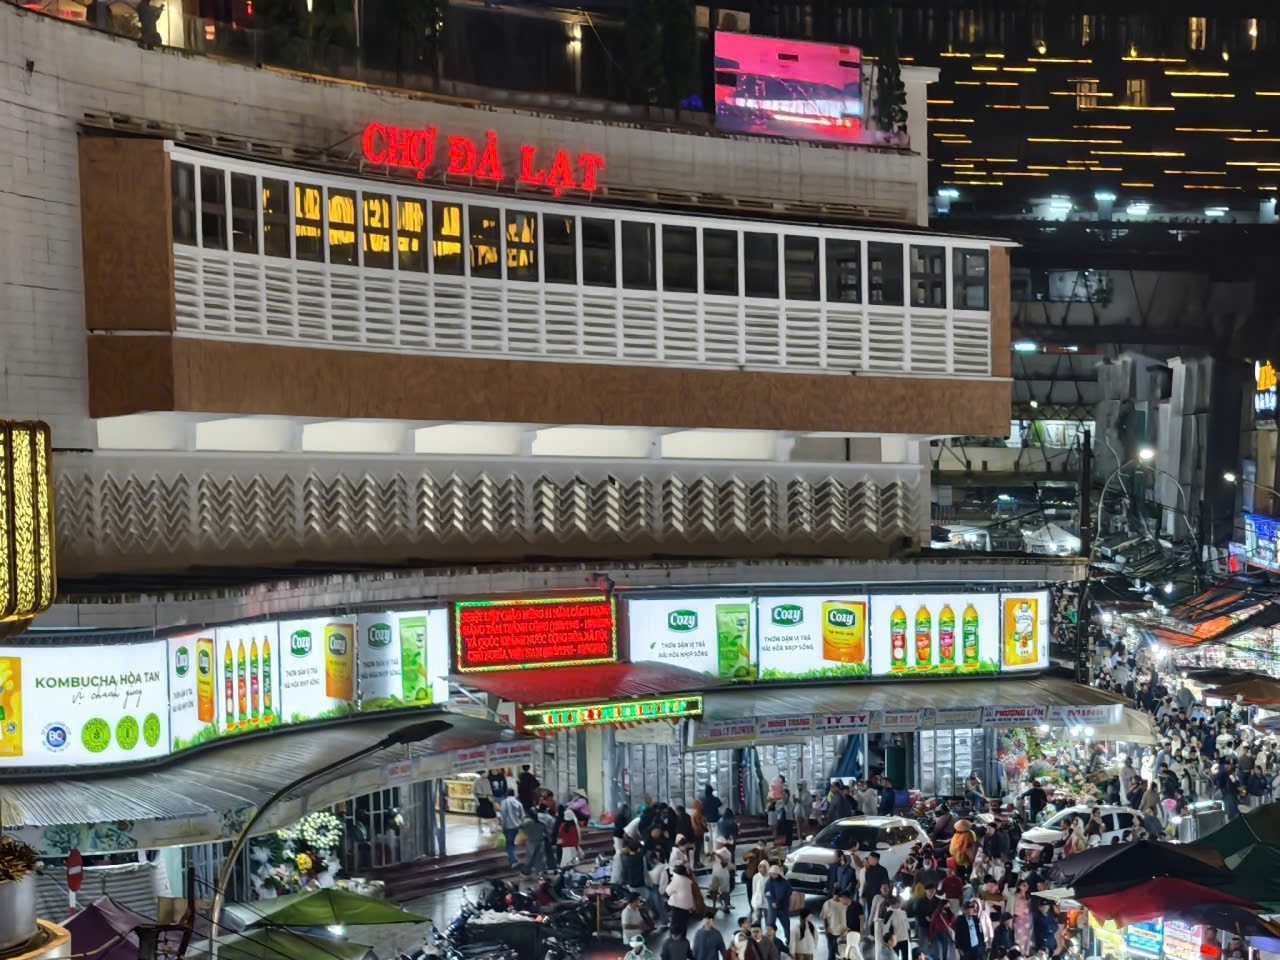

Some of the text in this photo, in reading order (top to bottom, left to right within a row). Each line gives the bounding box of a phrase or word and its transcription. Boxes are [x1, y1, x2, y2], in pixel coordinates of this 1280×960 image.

[361, 121, 605, 197] CHỢ ĐÀ LẠT
[670, 612, 697, 628] Cozy
[773, 608, 801, 622] Cozy
[829, 611, 854, 626] Cozy
[291, 635, 312, 651] Cozy
[35, 670, 160, 689] KOMBUCHA HÒA TAN
